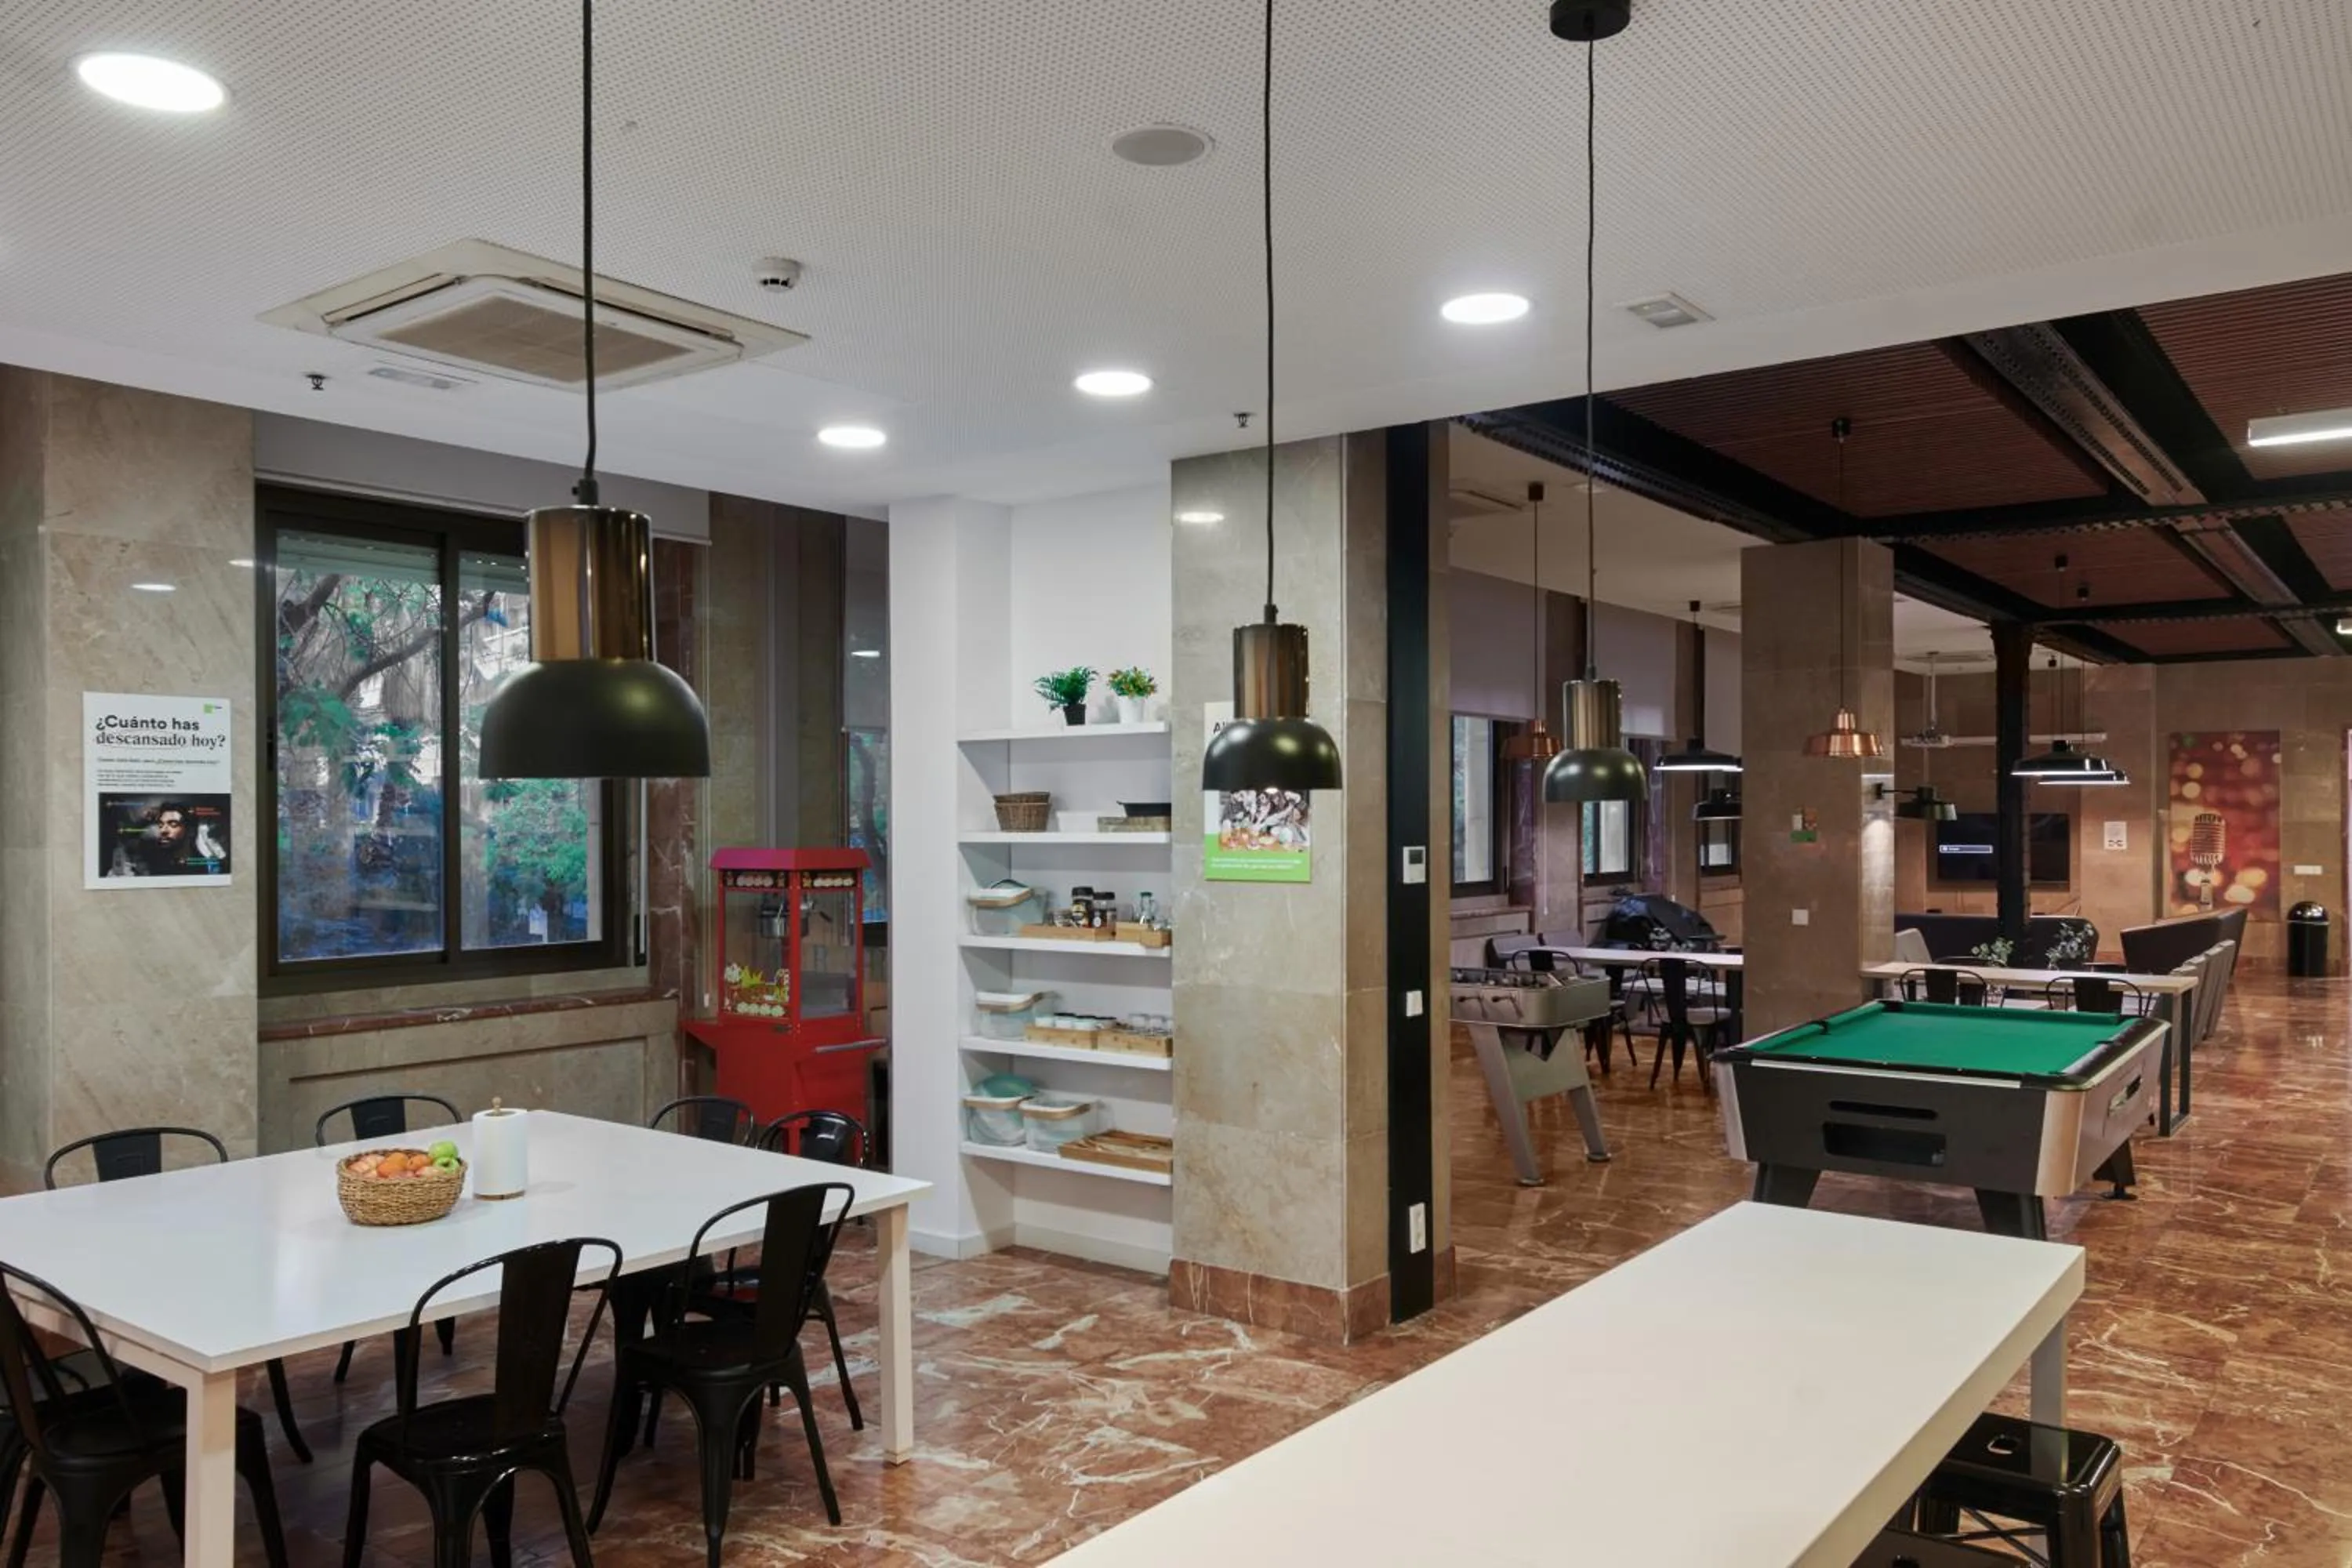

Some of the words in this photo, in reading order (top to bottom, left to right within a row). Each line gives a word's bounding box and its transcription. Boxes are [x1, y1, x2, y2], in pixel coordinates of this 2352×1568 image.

[96, 715, 167, 730] ¿Cuánto
[172, 718, 199, 730] has
[96, 732, 187, 745] descansado
[192, 735, 226, 750] hoy?
